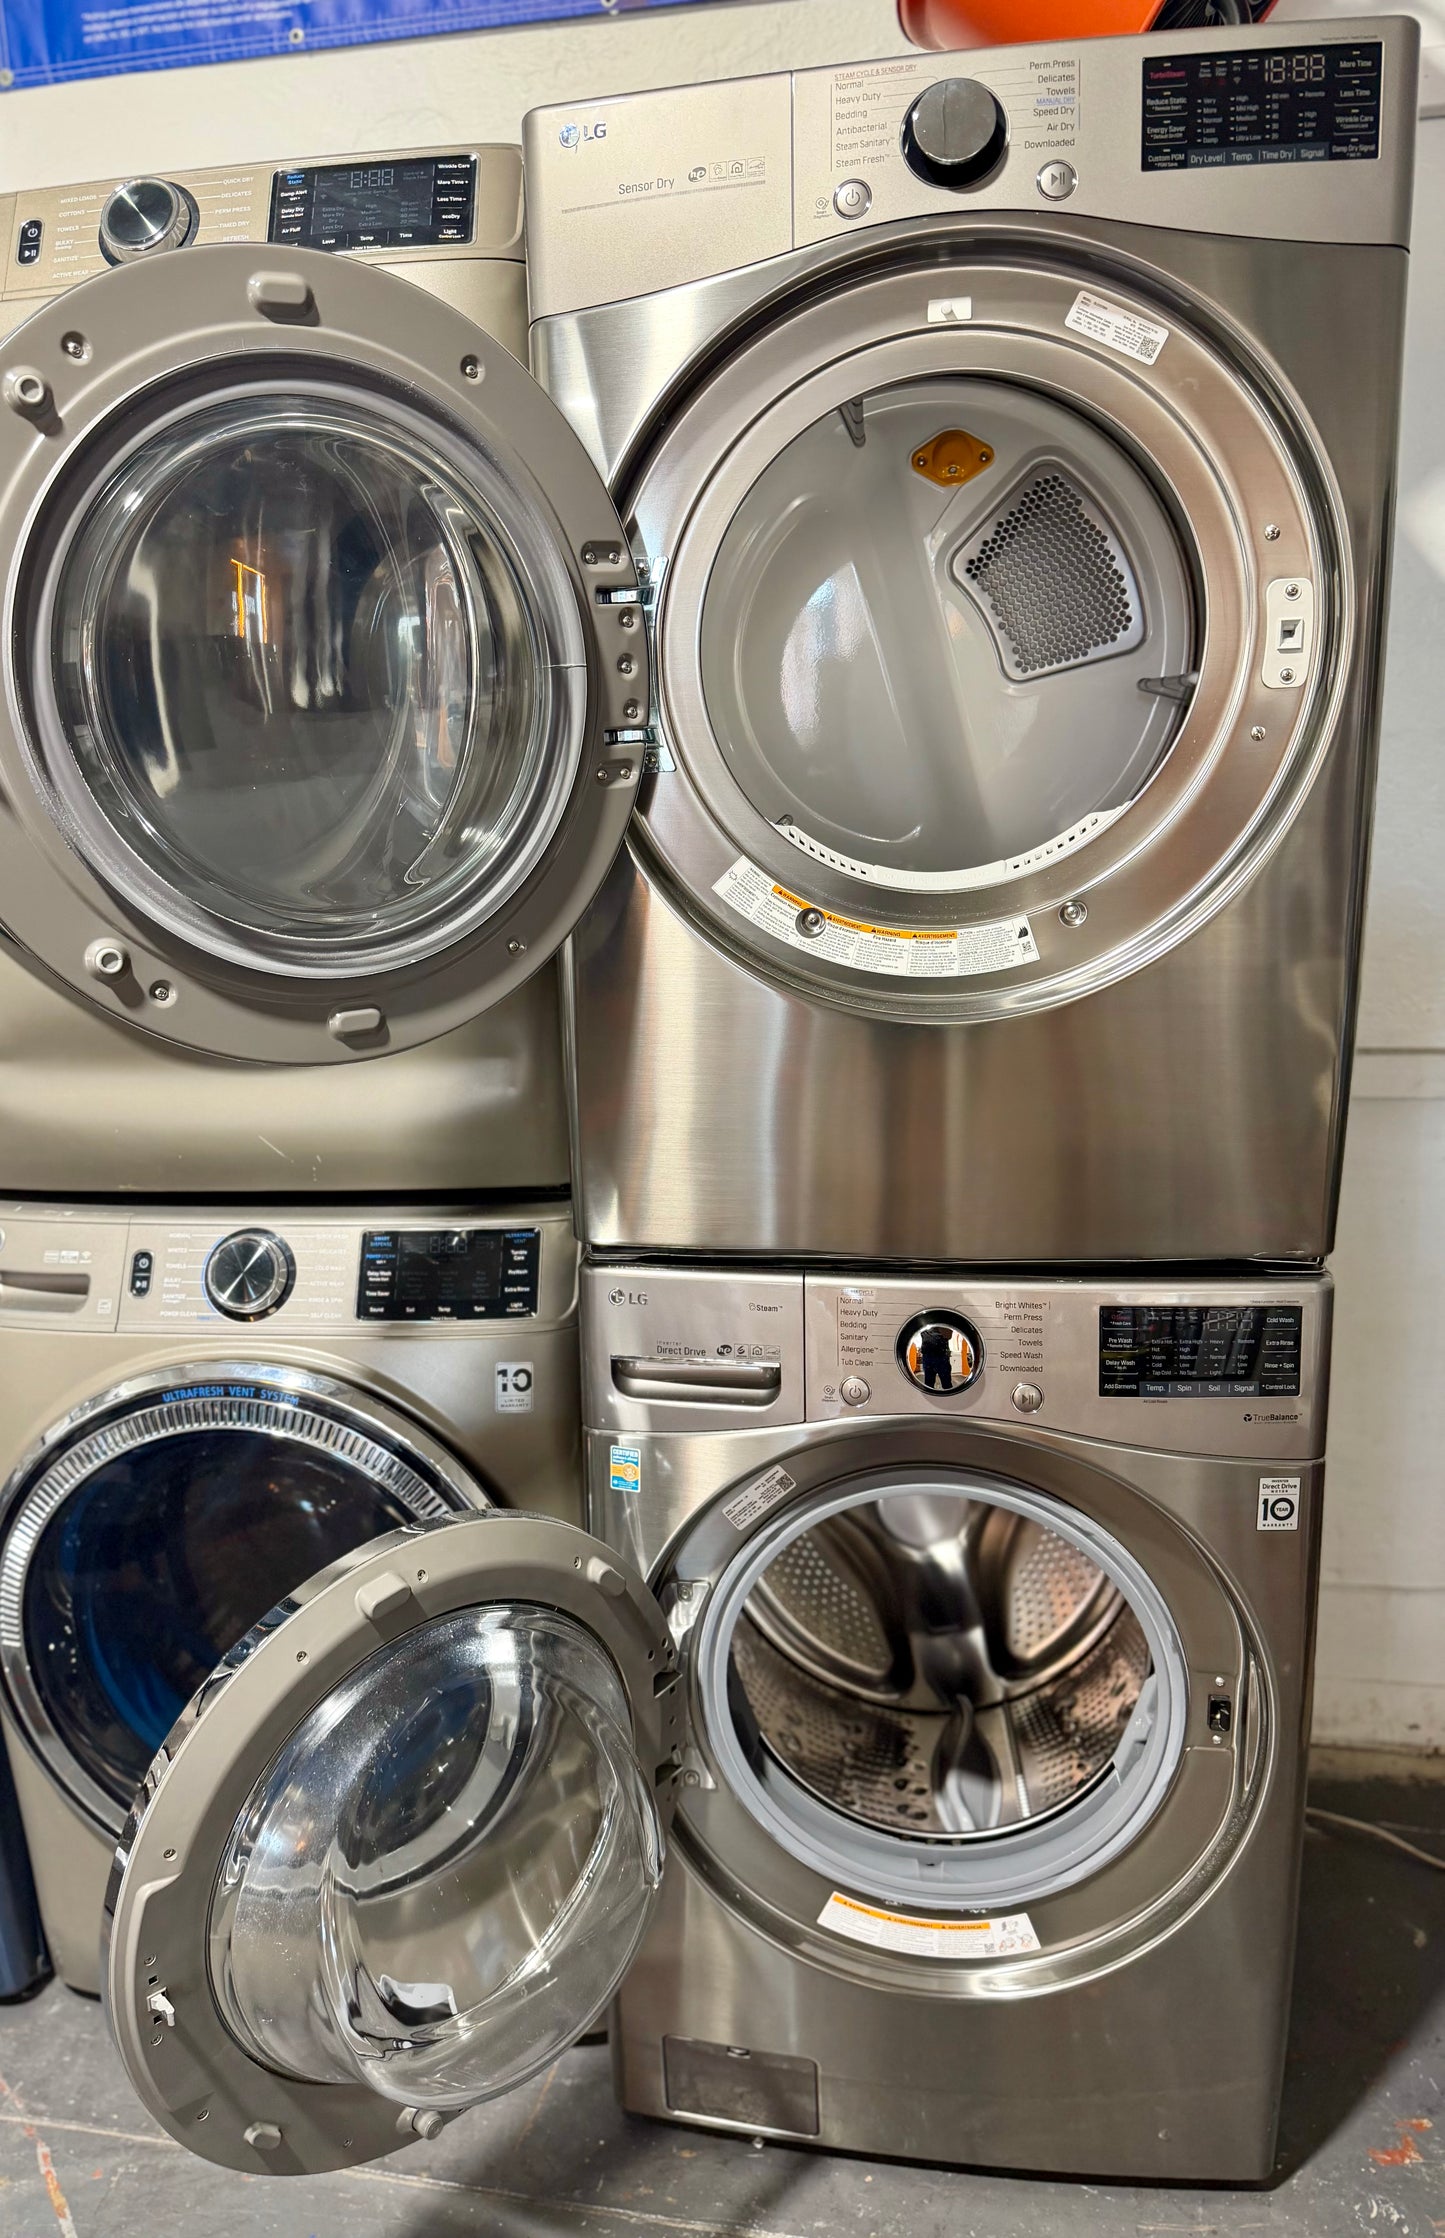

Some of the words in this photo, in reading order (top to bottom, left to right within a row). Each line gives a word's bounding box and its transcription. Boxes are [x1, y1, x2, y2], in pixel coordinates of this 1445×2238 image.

[1052, 59, 1076, 69] Press
[834, 72, 856, 81] STEAM
[856, 70, 874, 78] CYCLE
[881, 66, 904, 74] SENSOR
[905, 64, 917, 72] DRY
[1038, 74, 1076, 84] Delicates
[835, 80, 864, 91] Normal
[1046, 87, 1076, 96] Towels
[835, 95, 861, 105] Heavy
[862, 92, 882, 102] Duty
[1146, 98, 1169, 106] Reduce
[835, 109, 868, 121] Bedding
[1033, 106, 1058, 118] Speed
[1060, 106, 1075, 116] Dry
[584, 122, 607, 142] LG
[836, 122, 888, 136] Antibacterial
[1046, 123, 1059, 132] Air
[1060, 122, 1075, 132] Dry
[1146, 126, 1168, 136] Energy
[835, 141, 859, 152] Steam
[1024, 138, 1076, 150] Downloaded
[1148, 154, 1170, 163] Custom
[1170, 153, 1186, 161] PGM
[1190, 154, 1203, 164] Dry
[1204, 153, 1223, 163] Level
[1262, 151, 1279, 160] Time
[1280, 150, 1293, 160] Dry
[1300, 148, 1325, 160] Signal
[835, 158, 861, 168] Steam
[618, 181, 653, 195] Sensor
[656, 177, 675, 190] Dry
[79, 194, 97, 202] LOADS
[221, 190, 252, 198] DELICATES
[58, 210, 85, 218] COTTONS
[628, 1292, 648, 1306] LG
[995, 1302, 1016, 1310] Bright
[862, 1310, 878, 1318] Duty
[1024, 1314, 1042, 1322] Press
[840, 1321, 868, 1330] Bedding
[1011, 1326, 1043, 1334] Delicates
[840, 1333, 868, 1342] Sanitary
[656, 1345, 682, 1355] Direct
[684, 1346, 706, 1357] Drive
[1000, 1351, 1022, 1360] Speed
[841, 1358, 854, 1366] Tub
[1000, 1364, 1043, 1373] Downloaded
[496, 1368, 532, 1392] 10
[1178, 1384, 1192, 1392] Spin
[1208, 1384, 1220, 1392] Soil
[1234, 1384, 1254, 1392] Signal
[162, 1386, 224, 1402] ULTRAFRESH
[228, 1386, 256, 1398] VENT
[260, 1390, 300, 1406] SYSTEM
[1262, 1498, 1294, 1521] 10
